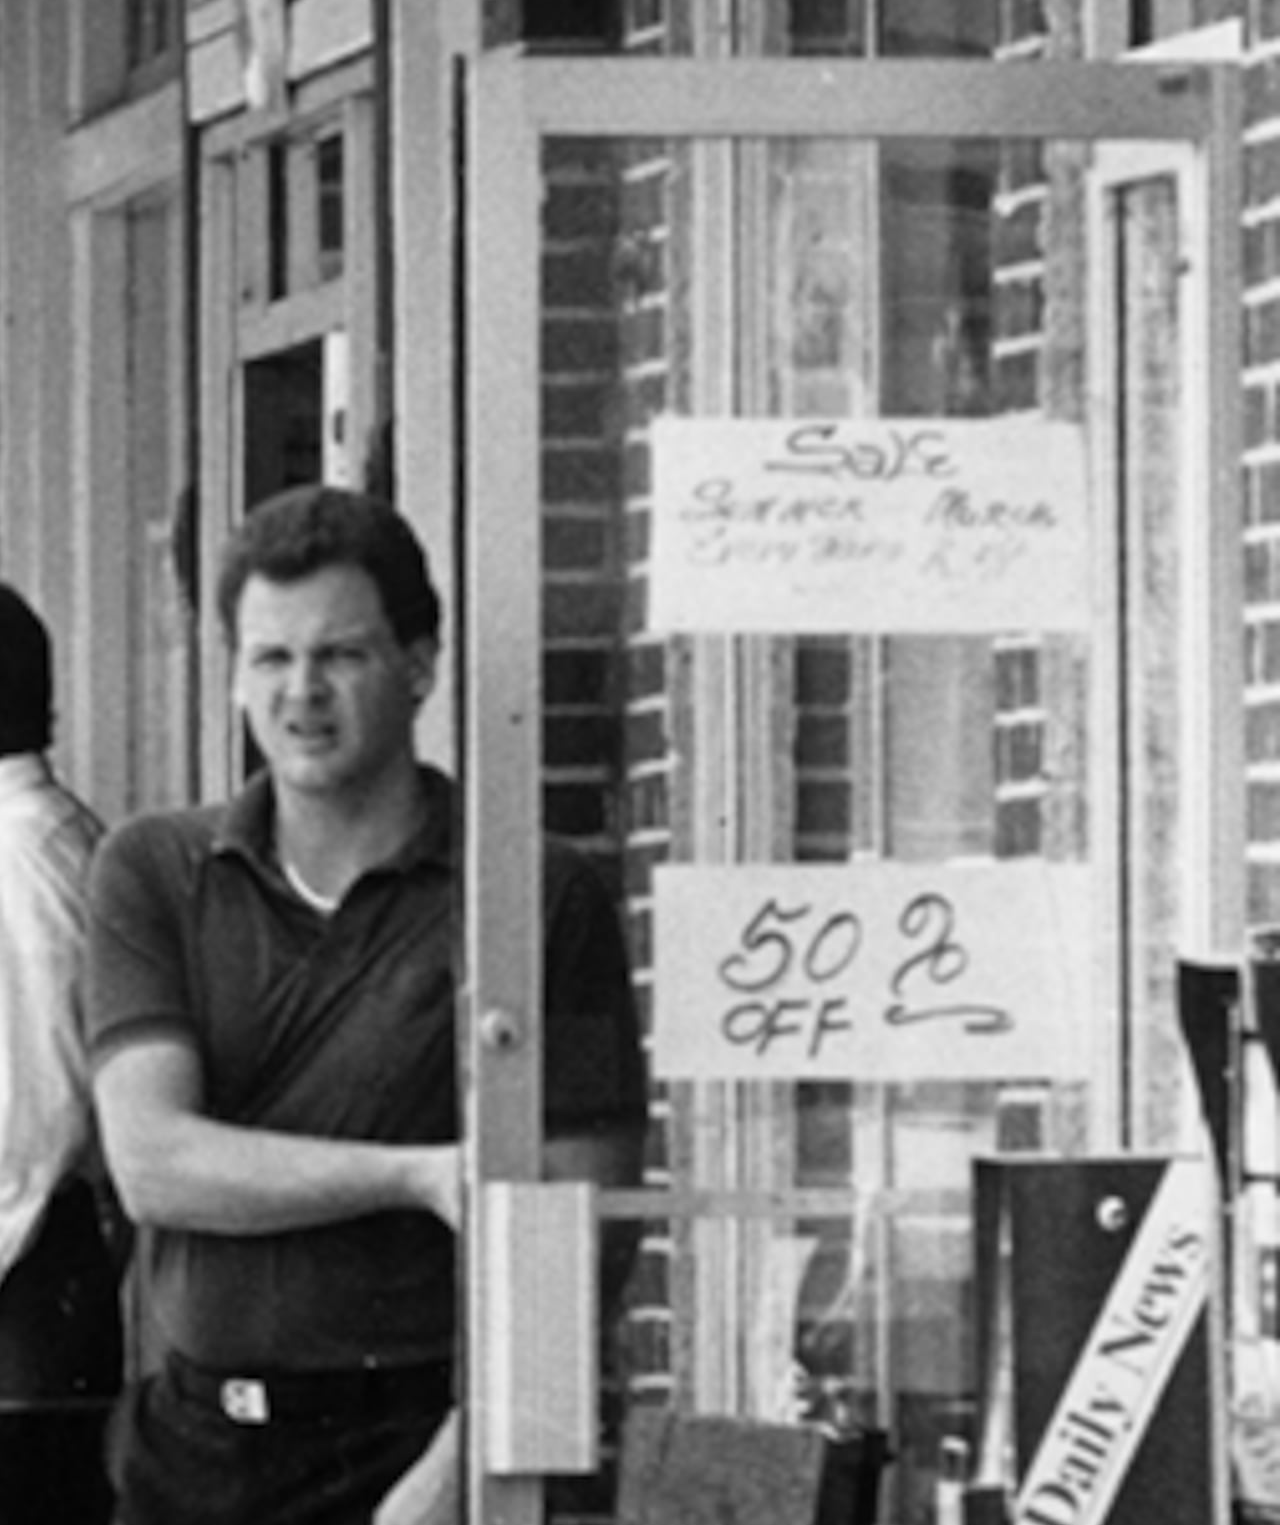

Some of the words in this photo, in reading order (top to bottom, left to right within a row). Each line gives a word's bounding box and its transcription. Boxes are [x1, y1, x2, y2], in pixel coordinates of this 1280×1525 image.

[717, 897, 864, 994] 50
[719, 996, 854, 1059] OFF
[1096, 1223, 1202, 1378] News
